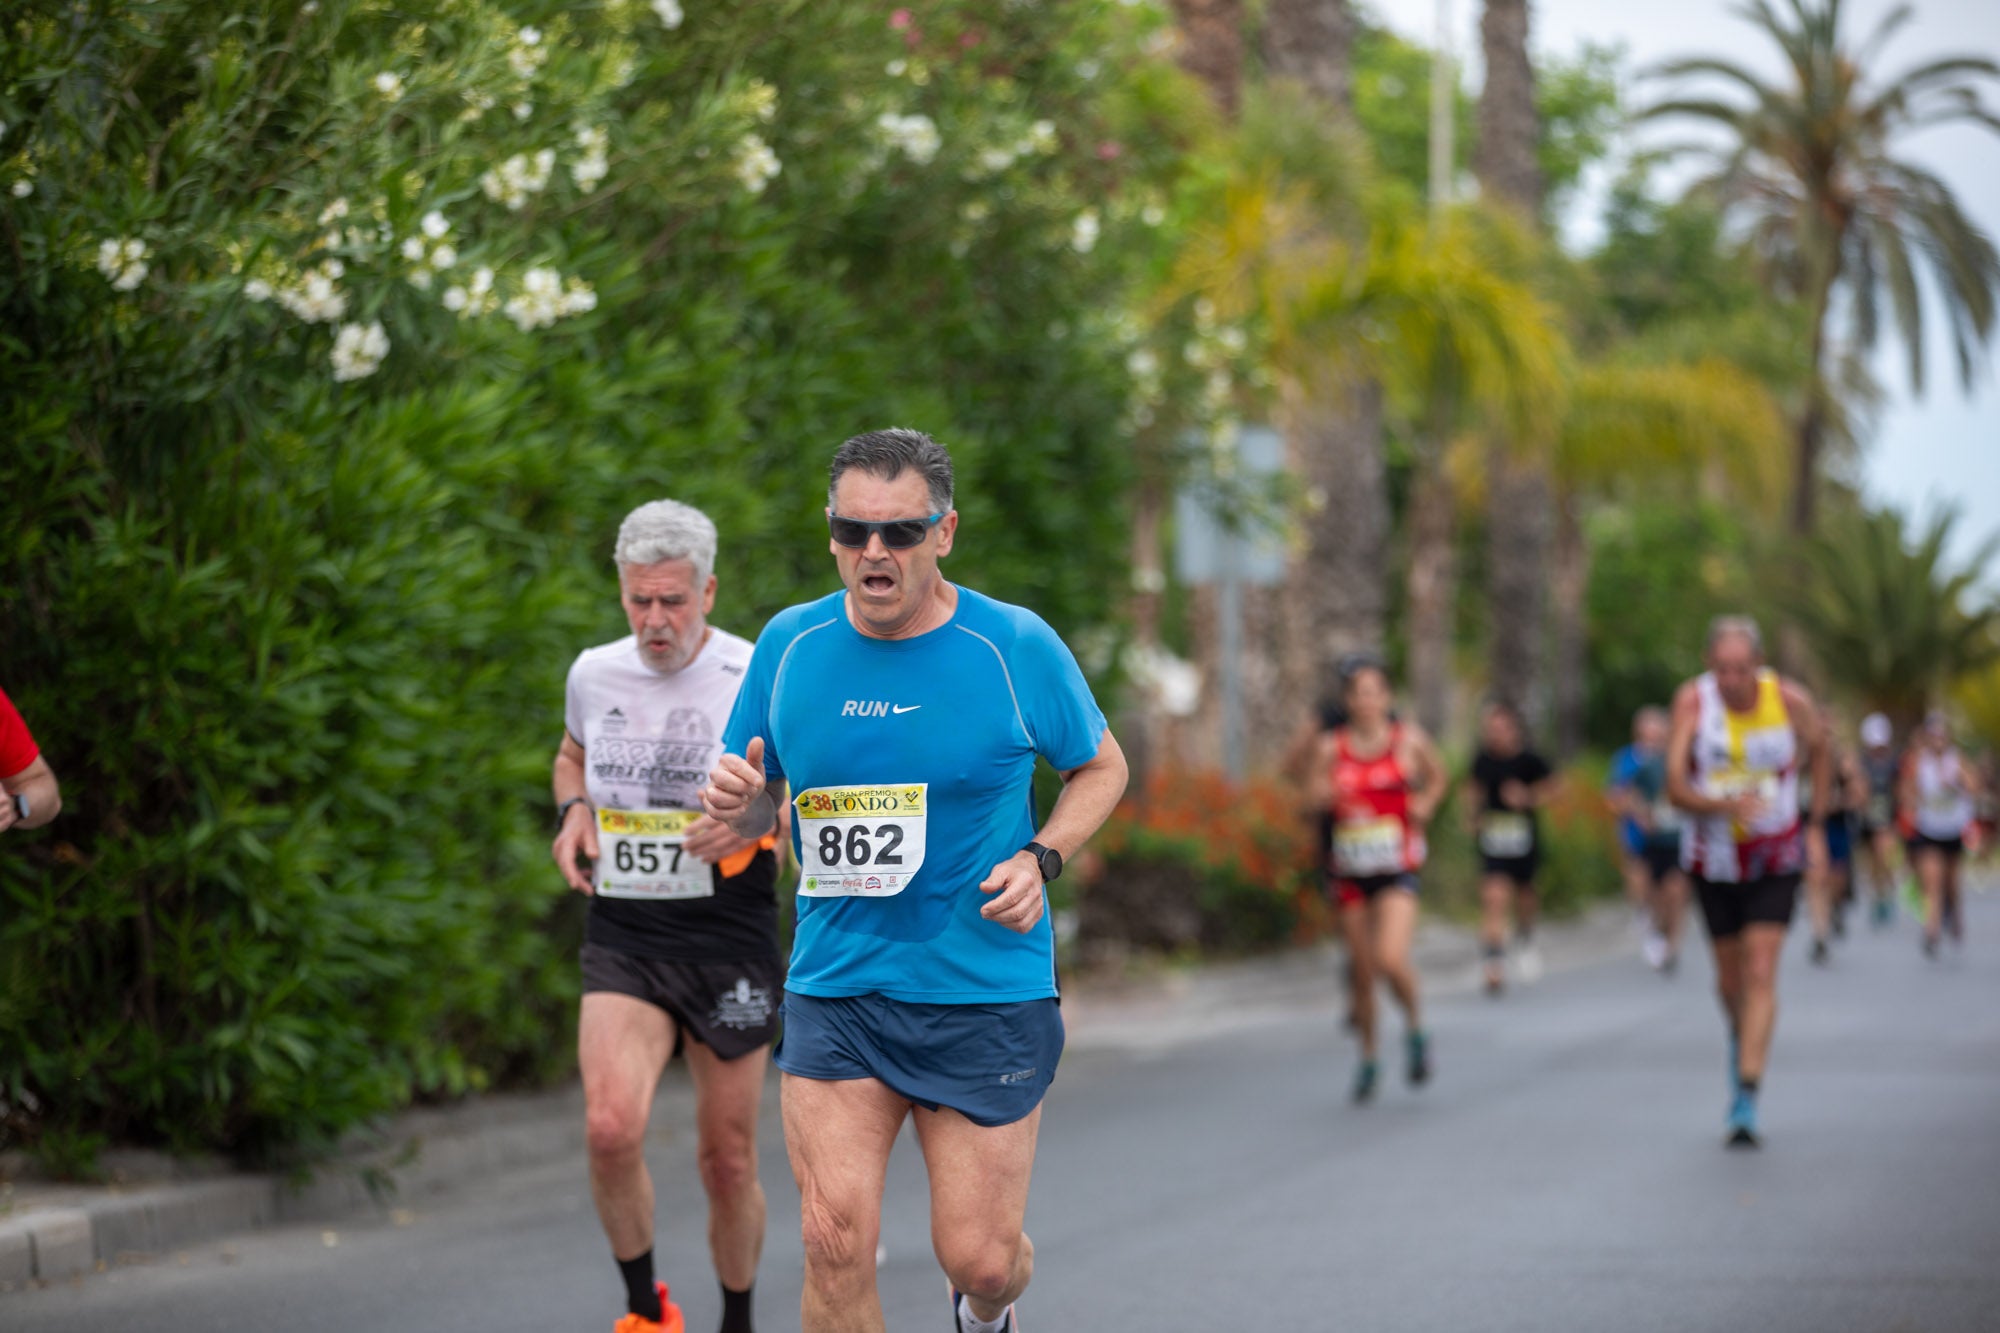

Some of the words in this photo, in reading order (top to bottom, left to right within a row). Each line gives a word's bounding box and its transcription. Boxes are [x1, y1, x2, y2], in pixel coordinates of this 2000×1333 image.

[841, 700, 890, 718] RUN
[811, 794, 832, 812] 38
[833, 791, 857, 799] GRAN
[859, 789, 892, 797] PREMIO
[832, 796, 898, 812] FONDO
[818, 824, 904, 867] 862
[615, 840, 684, 874] 657
